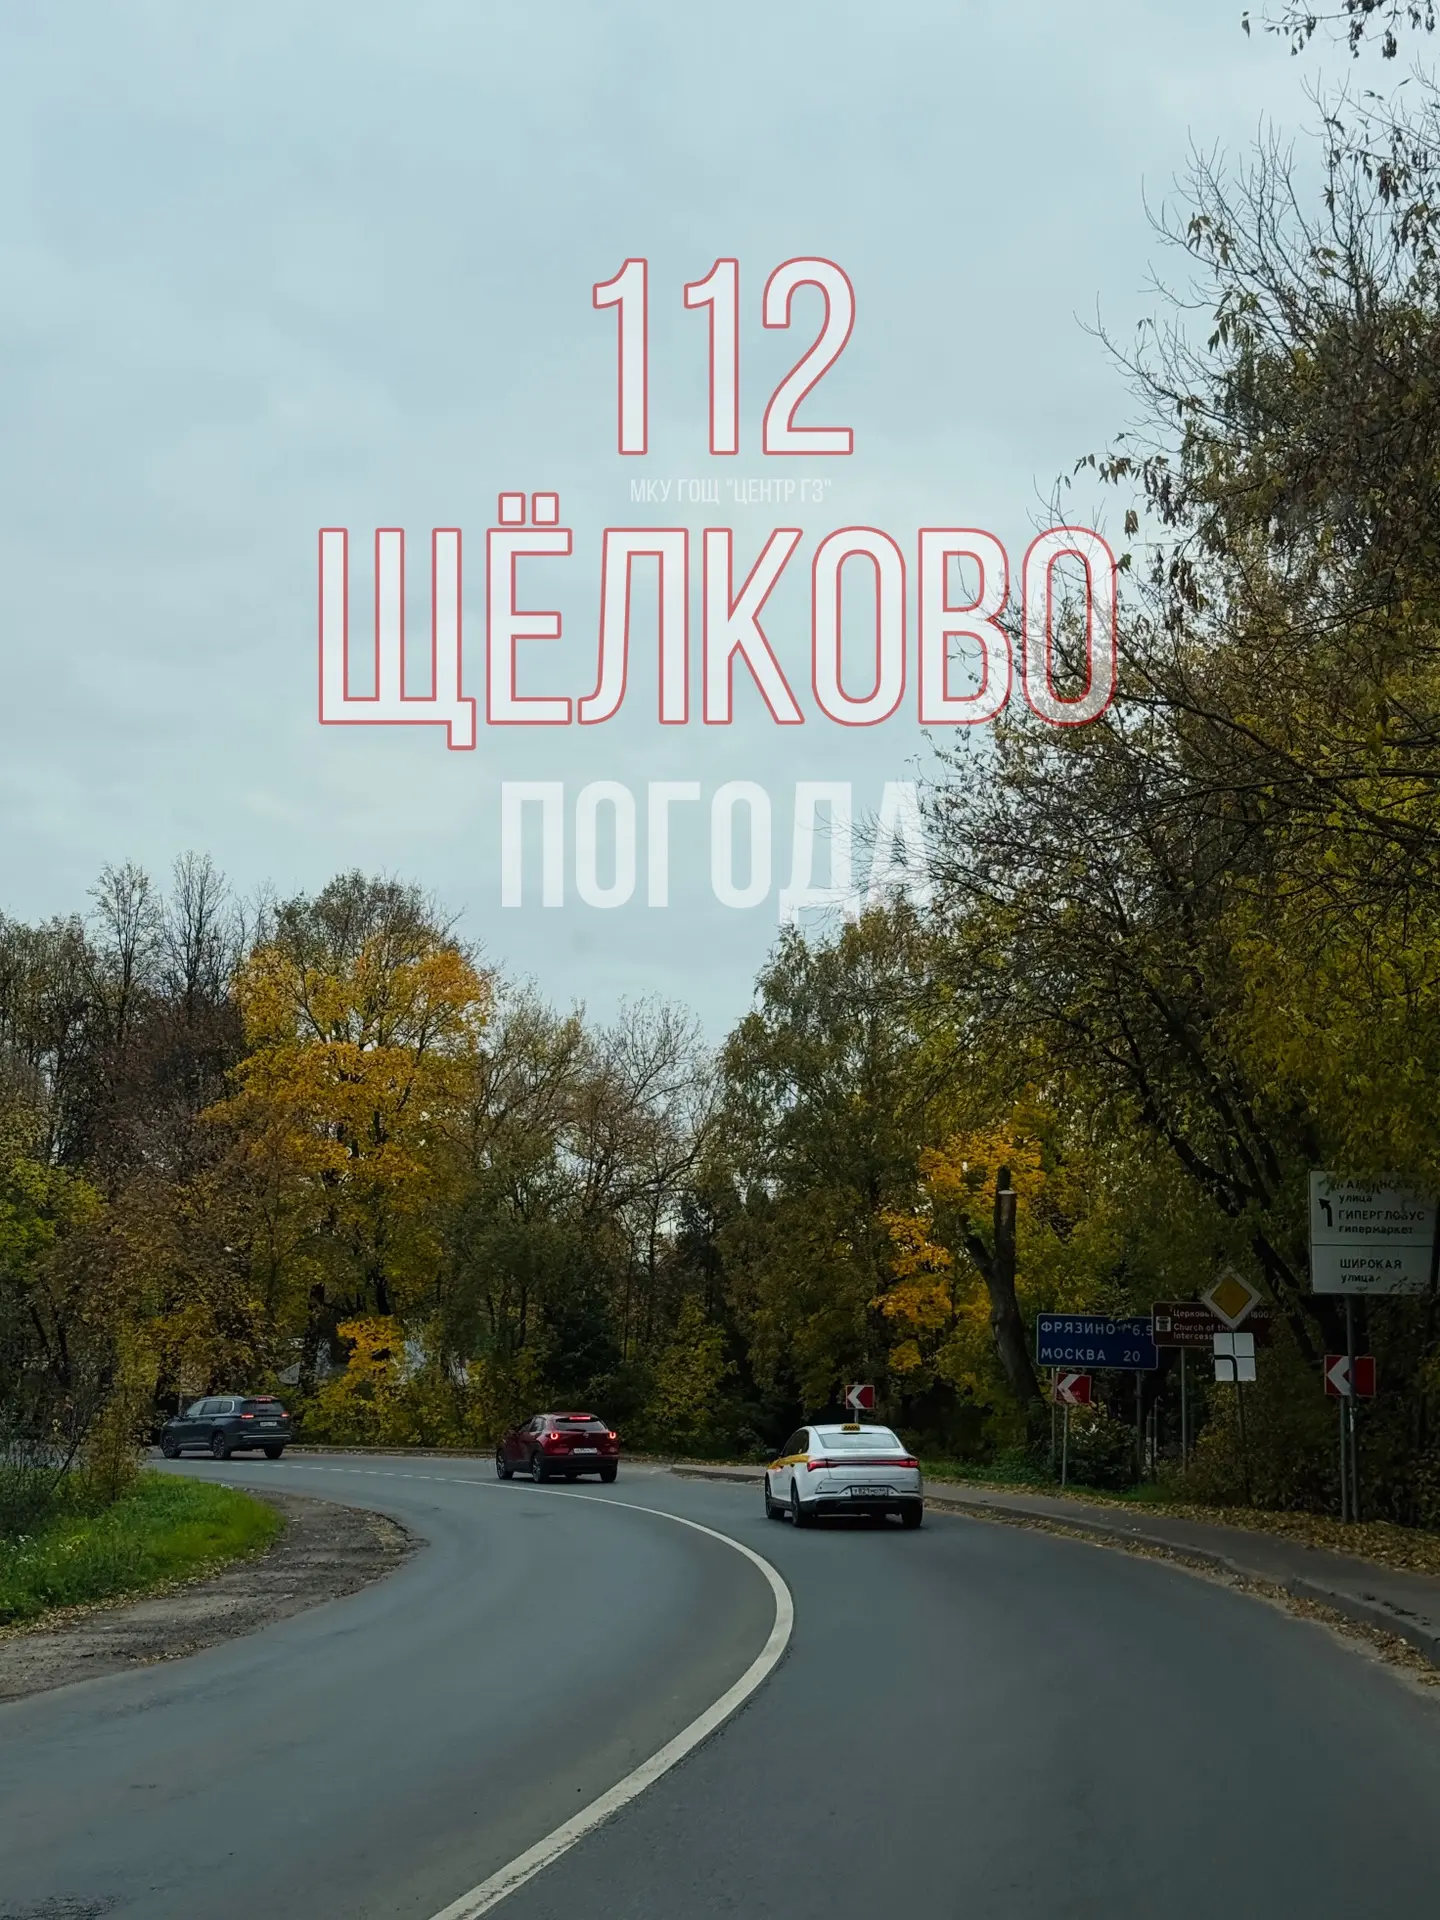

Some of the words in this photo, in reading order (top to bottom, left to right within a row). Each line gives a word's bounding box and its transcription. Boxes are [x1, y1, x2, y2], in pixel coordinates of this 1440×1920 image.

[1339, 1193, 1372, 1204] улица
[1338, 1225, 1413, 1236] гипермаркет
[1340, 1259, 1402, 1269] ШИРОКАЯ
[1341, 1274, 1374, 1284] улица
[1040, 1321, 1116, 1335] ФРЯЗИНО
[1173, 1322, 1204, 1331] Church
[1206, 1323, 1215, 1331] of
[1173, 1331, 1214, 1340] Intercess
[1040, 1347, 1107, 1361] МОСКВА
[1123, 1350, 1141, 1362] 20
